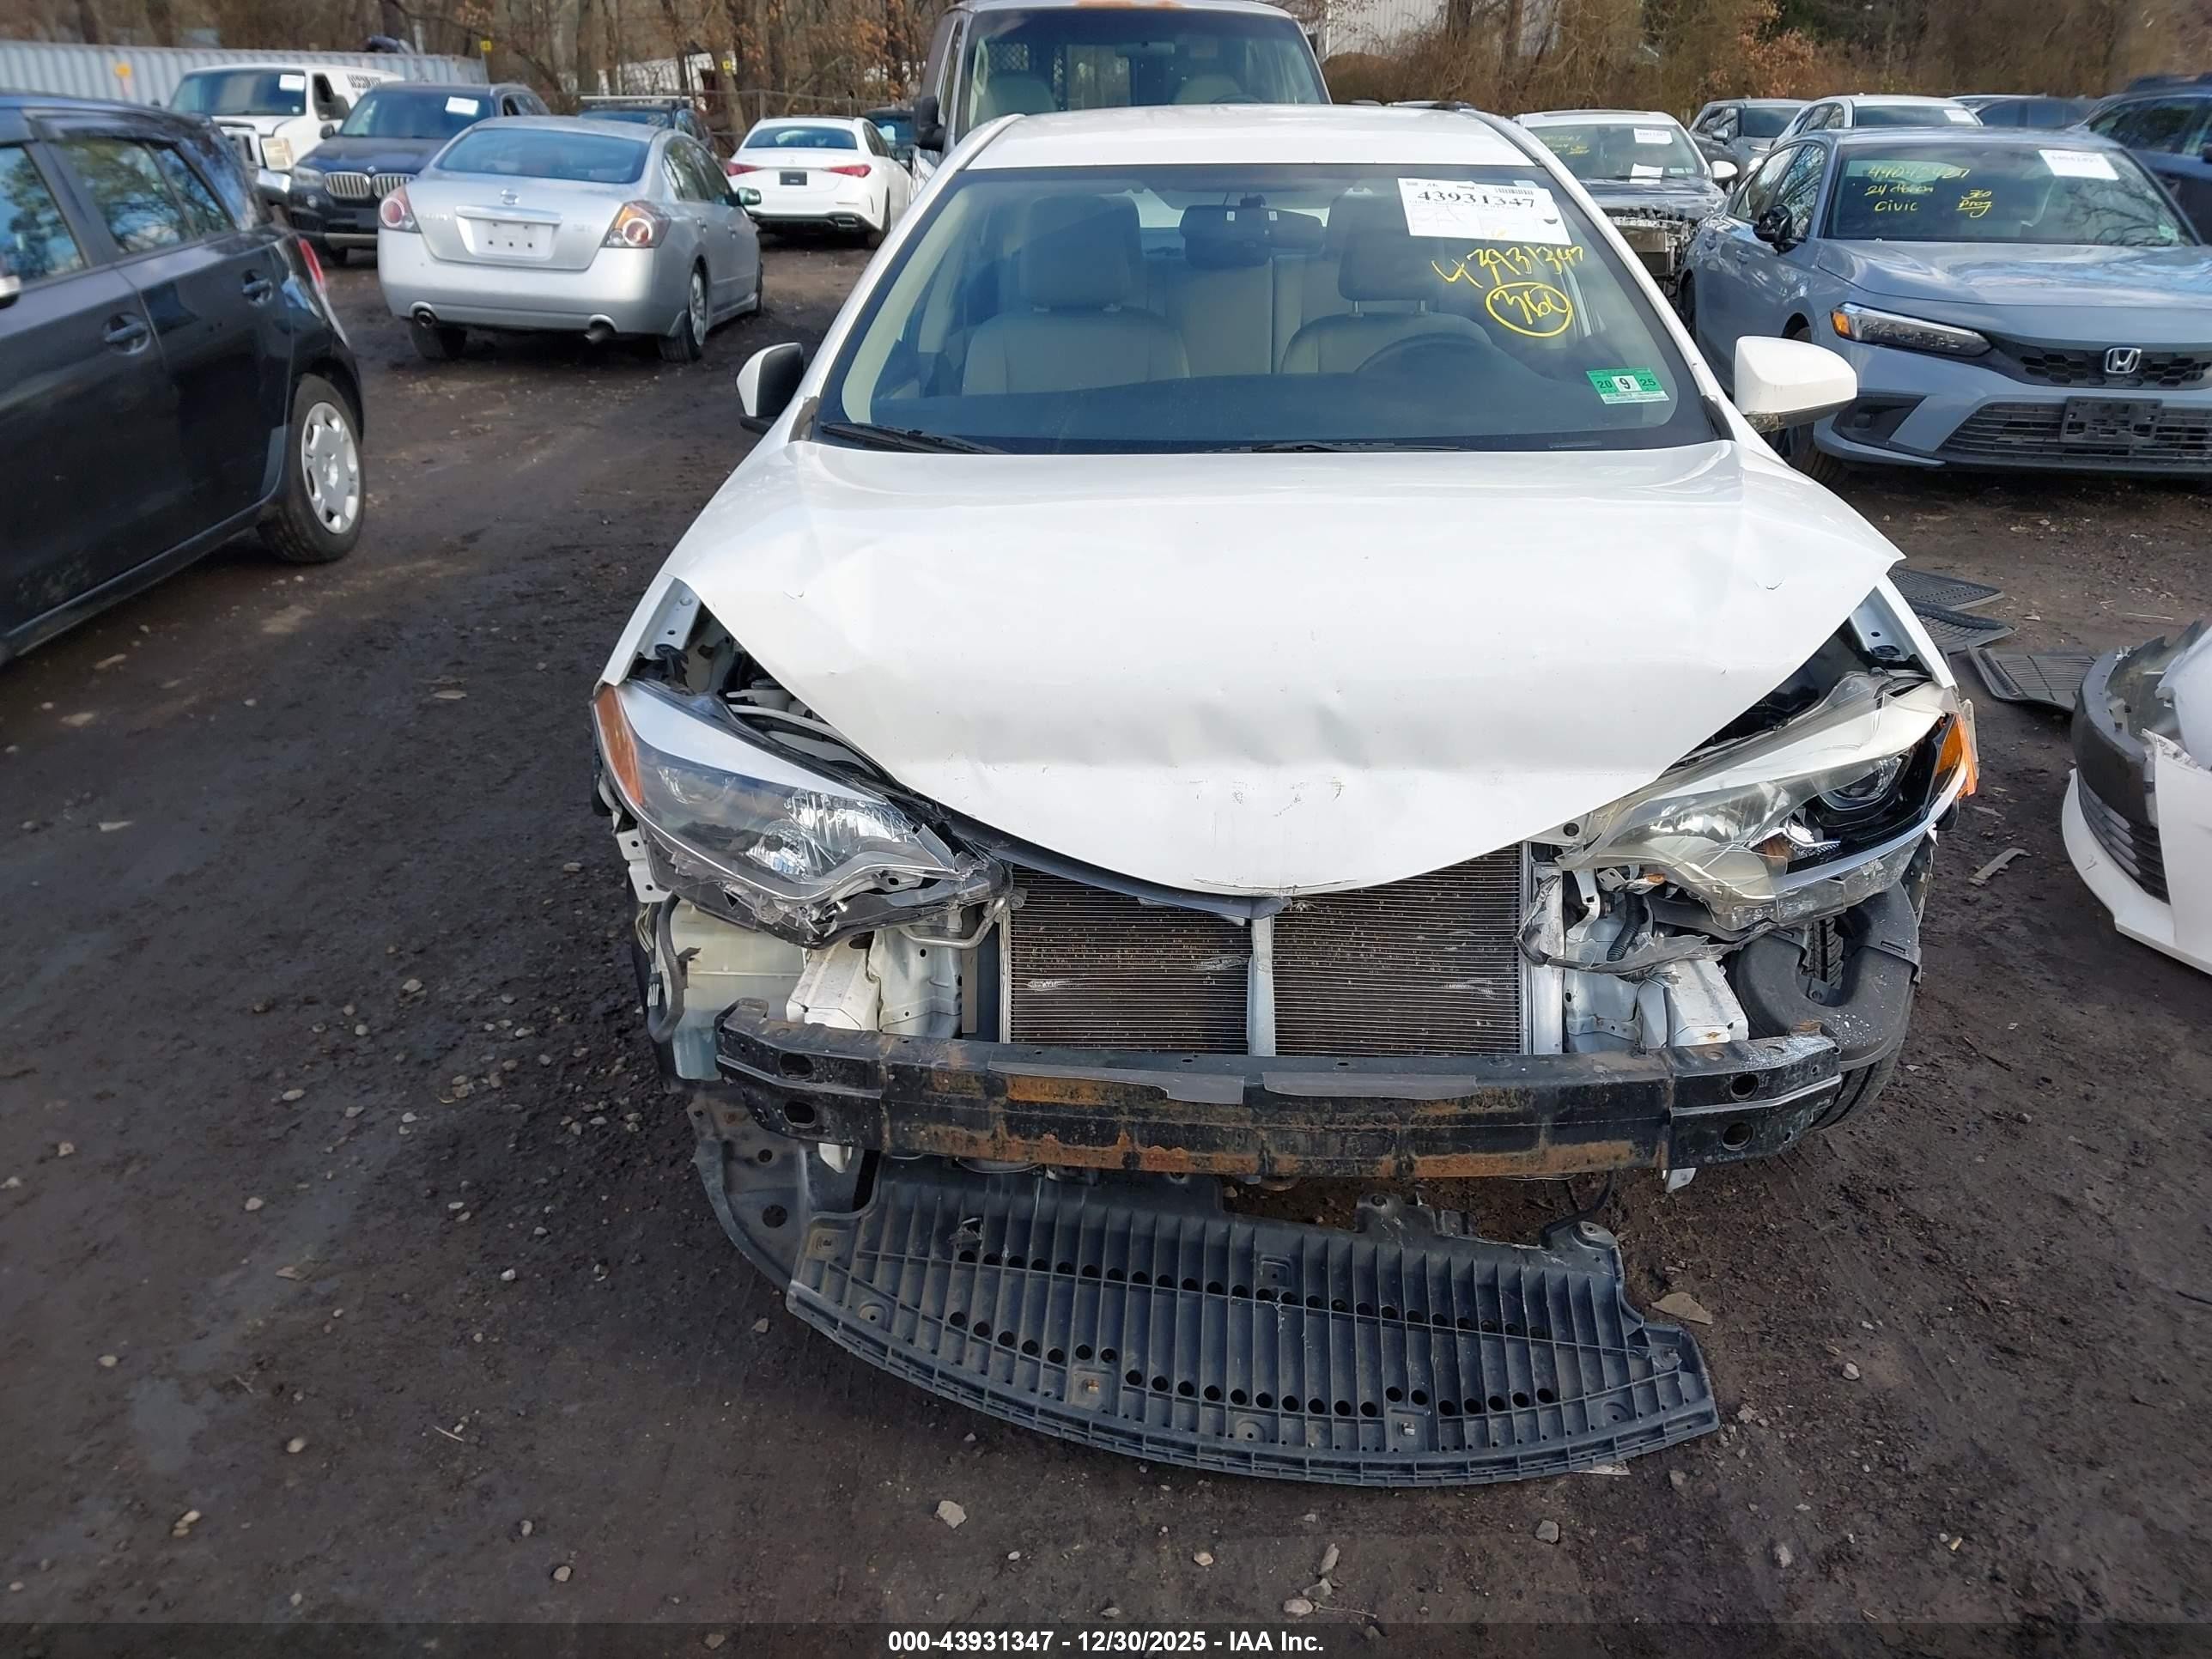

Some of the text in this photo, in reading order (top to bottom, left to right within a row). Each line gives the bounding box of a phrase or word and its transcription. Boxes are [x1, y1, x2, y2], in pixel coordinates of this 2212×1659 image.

[1417, 190, 1535, 208] 43931347
[1597, 377, 1656, 390] 20 9 25
